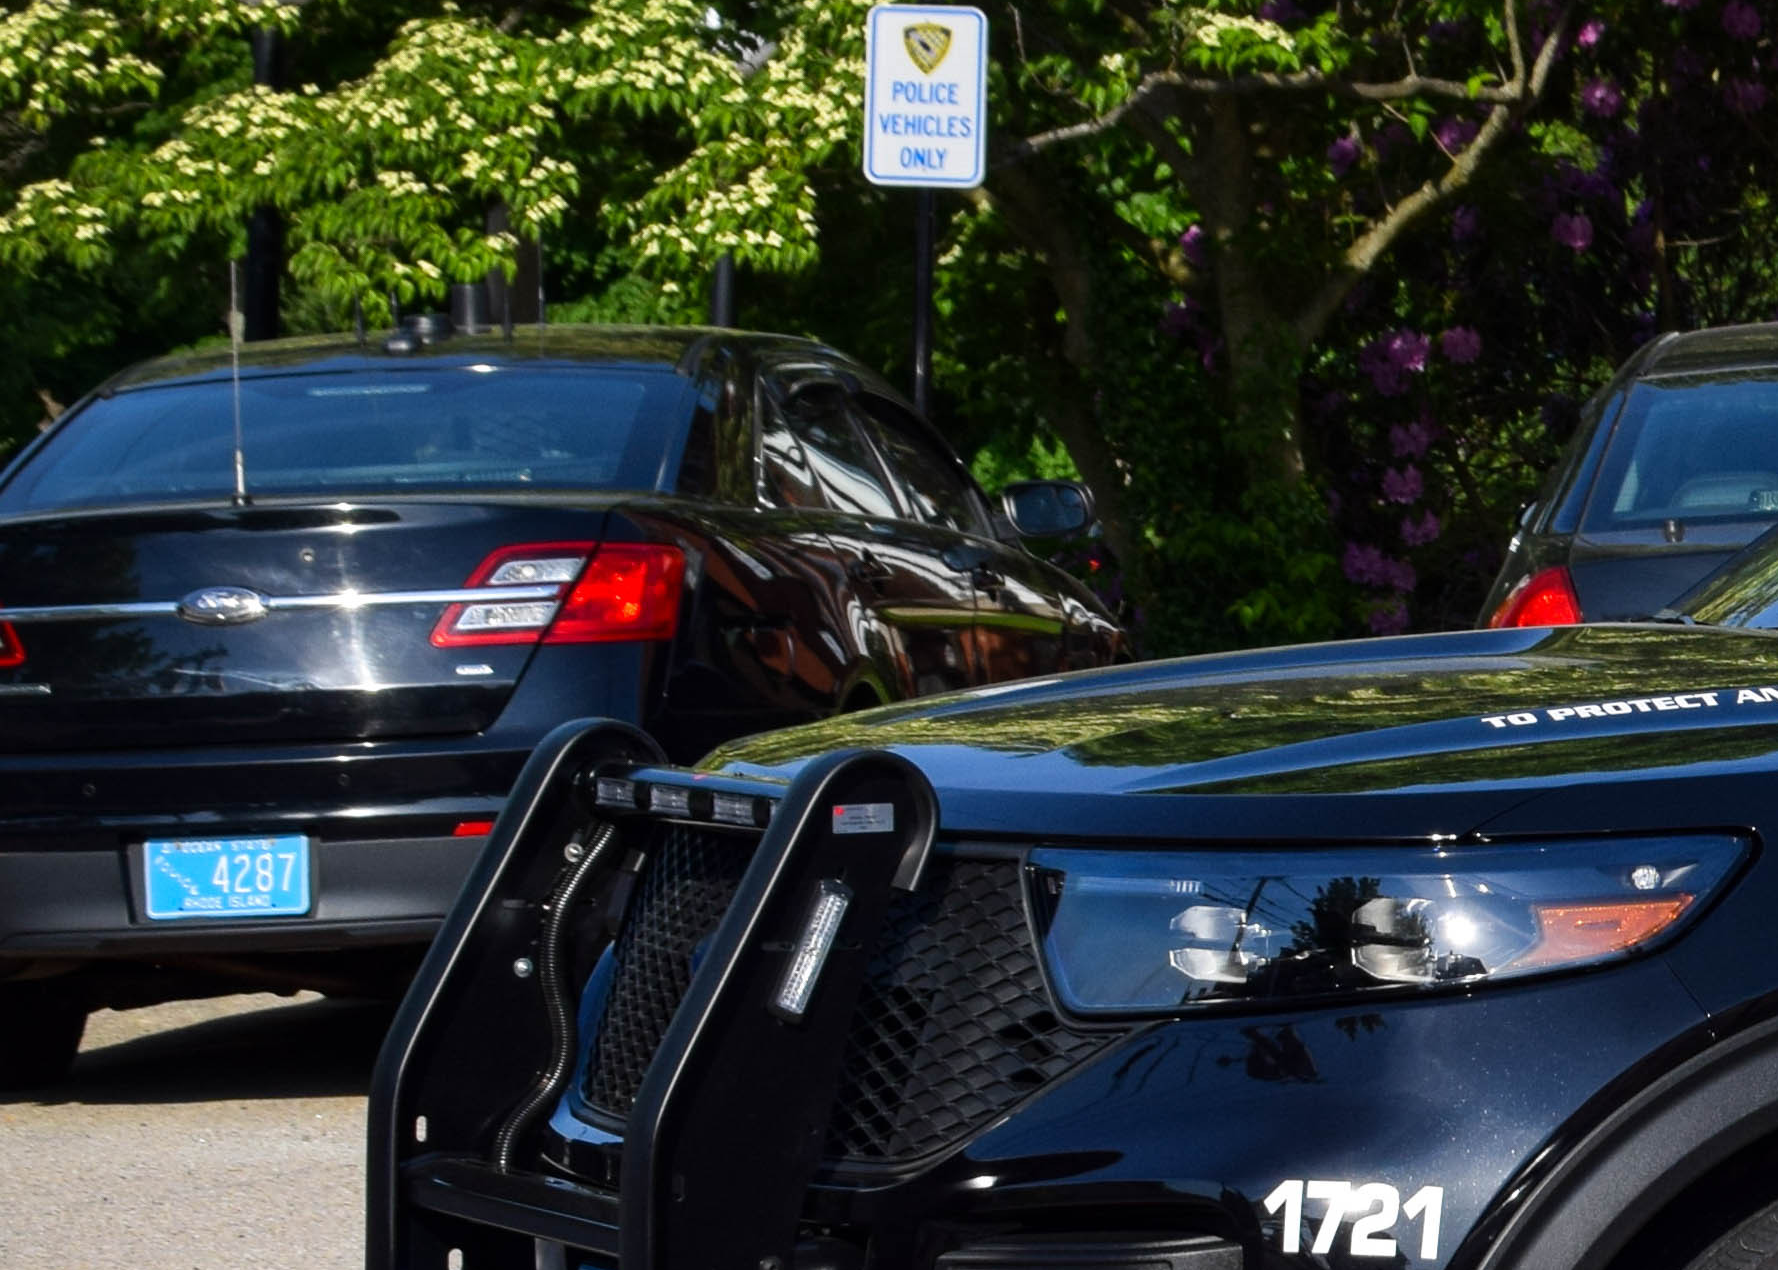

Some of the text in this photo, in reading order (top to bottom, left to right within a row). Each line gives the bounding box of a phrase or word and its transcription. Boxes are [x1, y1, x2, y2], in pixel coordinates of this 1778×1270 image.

[892, 81, 959, 105] POLICE
[879, 113, 972, 139] VEHICLES
[900, 146, 947, 170] ONLY
[1481, 711, 1538, 728] TO
[1546, 692, 1719, 722] PROTECT
[212, 852, 297, 894] 4287
[184, 895, 271, 909] RHODE ISLAND
[1263, 1179, 1444, 1261] 1721
